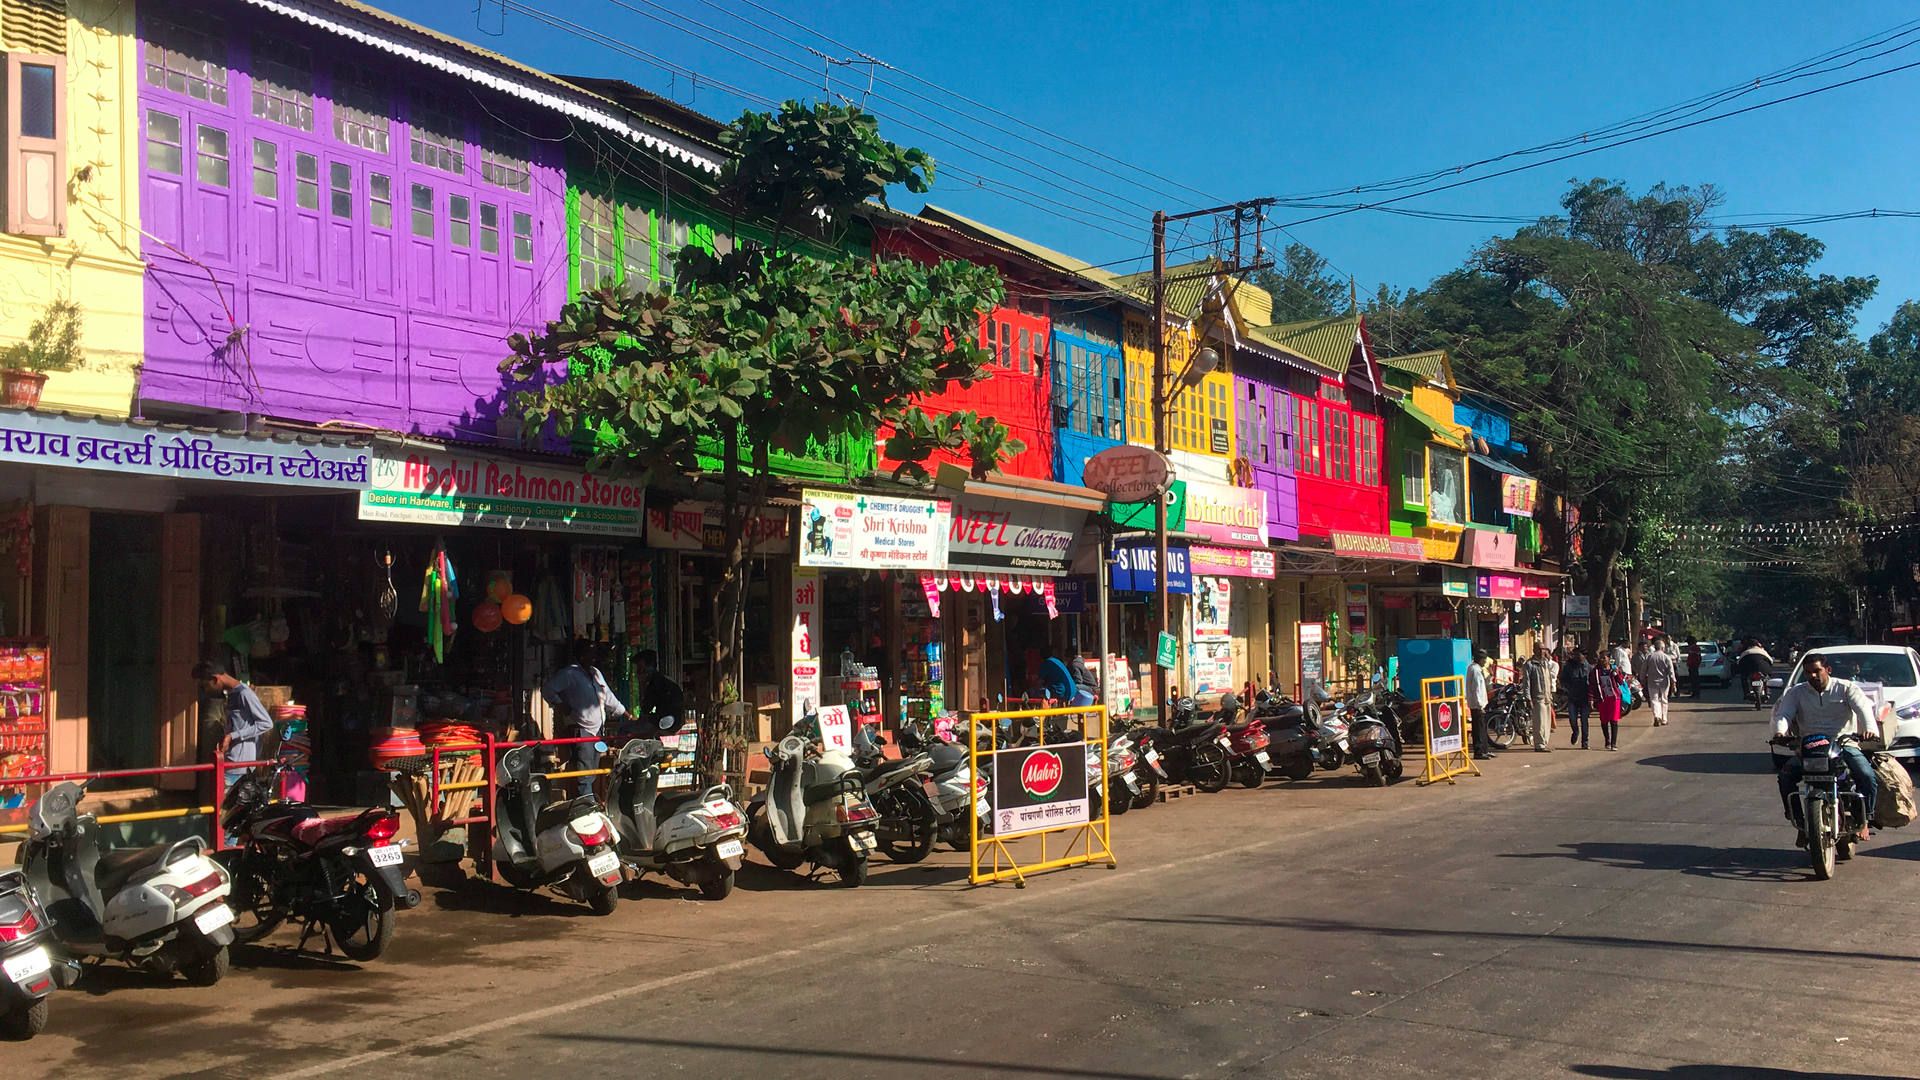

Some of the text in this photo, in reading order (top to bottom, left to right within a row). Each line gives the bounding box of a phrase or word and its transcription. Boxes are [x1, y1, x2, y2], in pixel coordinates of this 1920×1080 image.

[76, 433, 156, 466] ब्रदर्स
[159, 437, 274, 476] प्रोव्हिजन
[279, 449, 368, 483] स्टोअर्स
[1089, 454, 1158, 477] NEEL
[403, 454, 641, 508] Abdul Rehman Stores
[1096, 478, 1157, 493] Collections
[368, 493, 397, 504] Dealer
[399, 495, 407, 505] in
[410, 497, 452, 510] Hardware,
[869, 502, 893, 512] CHEMIST
[899, 504, 924, 513] DRUGGIST
[863, 516, 928, 535] Shri Krishna
[949, 504, 1011, 547] NEEL
[874, 536, 916, 547] Medical Stores
[1332, 533, 1391, 553] MADHUSAGAR
[1015, 558, 1037, 569] Complete
[1036, 560, 1050, 570] Family
[1120, 548, 1185, 574] SAMSNG
[1025, 763, 1060, 784] Malvi's
[1020, 808, 1043, 822] पांचगणी
[1045, 804, 1064, 818] पोलिस
[1065, 803, 1081, 815] स्टेशन
[374, 852, 401, 863] 3265
